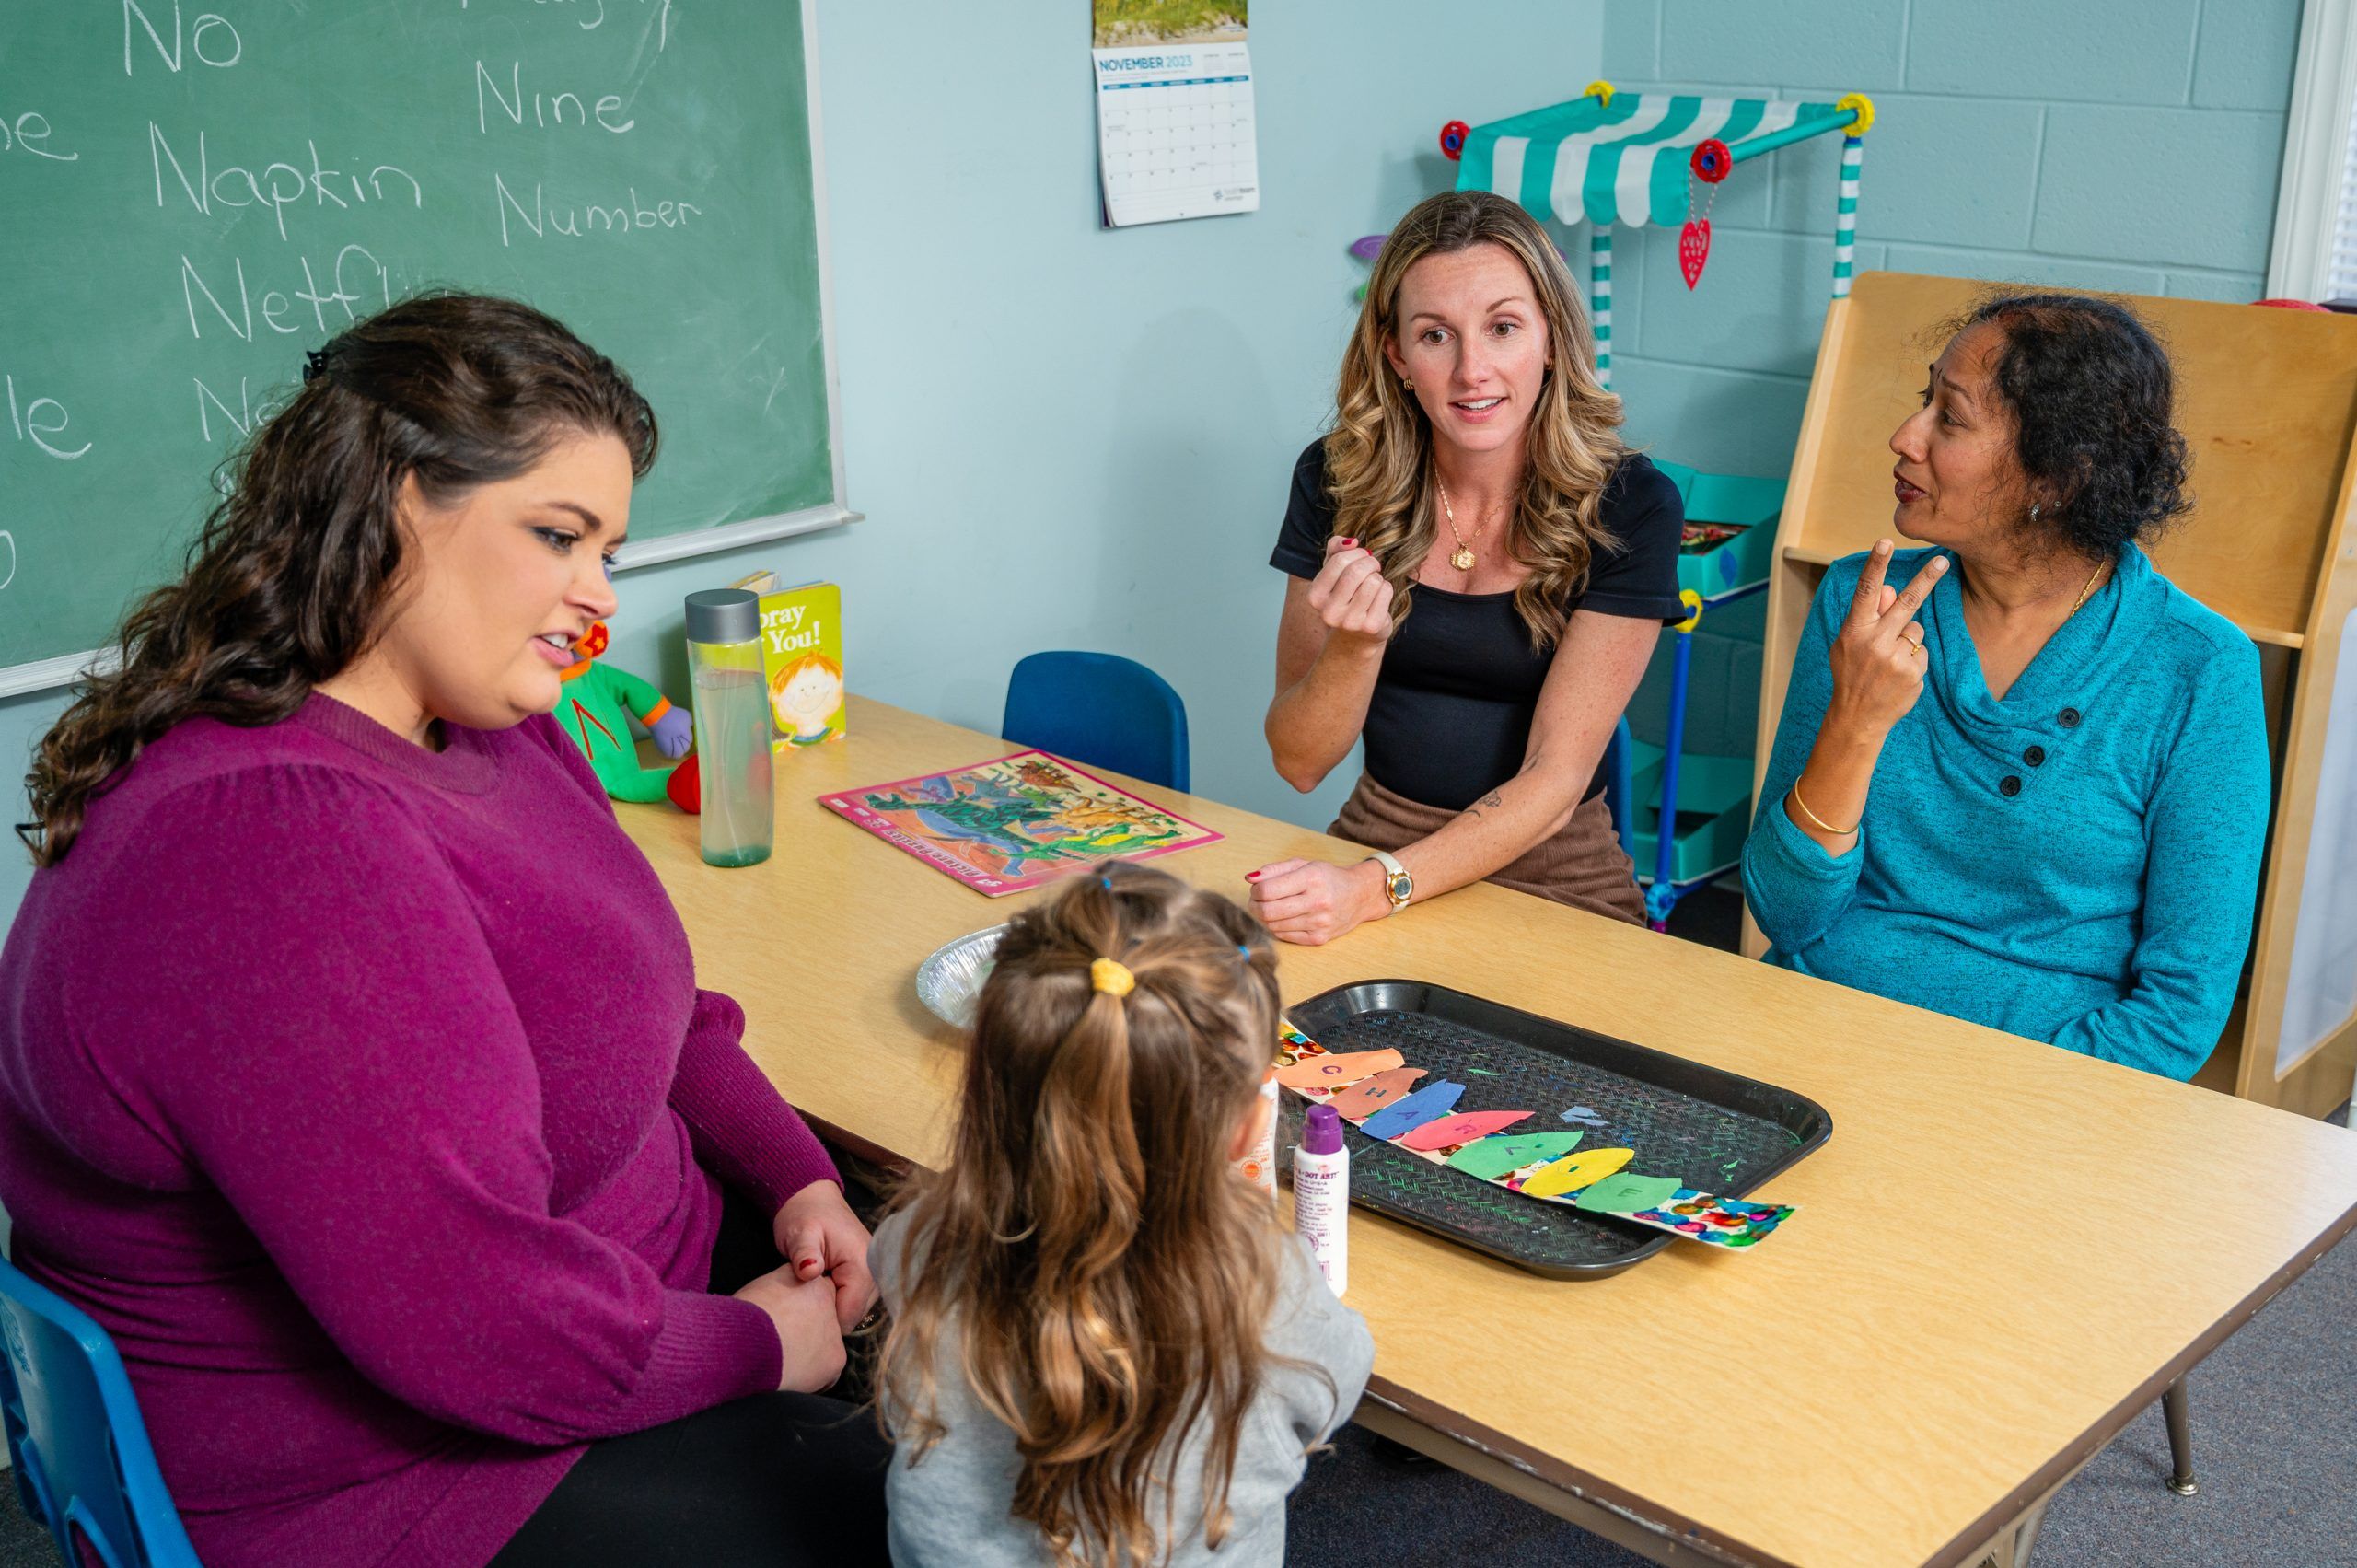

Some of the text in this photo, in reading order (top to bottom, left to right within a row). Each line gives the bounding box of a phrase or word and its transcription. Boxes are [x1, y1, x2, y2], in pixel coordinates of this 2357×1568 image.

[123, 0, 241, 76] No
[1099, 57, 1164, 72] NOVEMBER
[1166, 55, 1193, 68] 2023
[475, 60, 635, 134] Nine
[148, 121, 422, 241] Napkin
[495, 172, 702, 247] Number
[767, 620, 820, 655] You!
